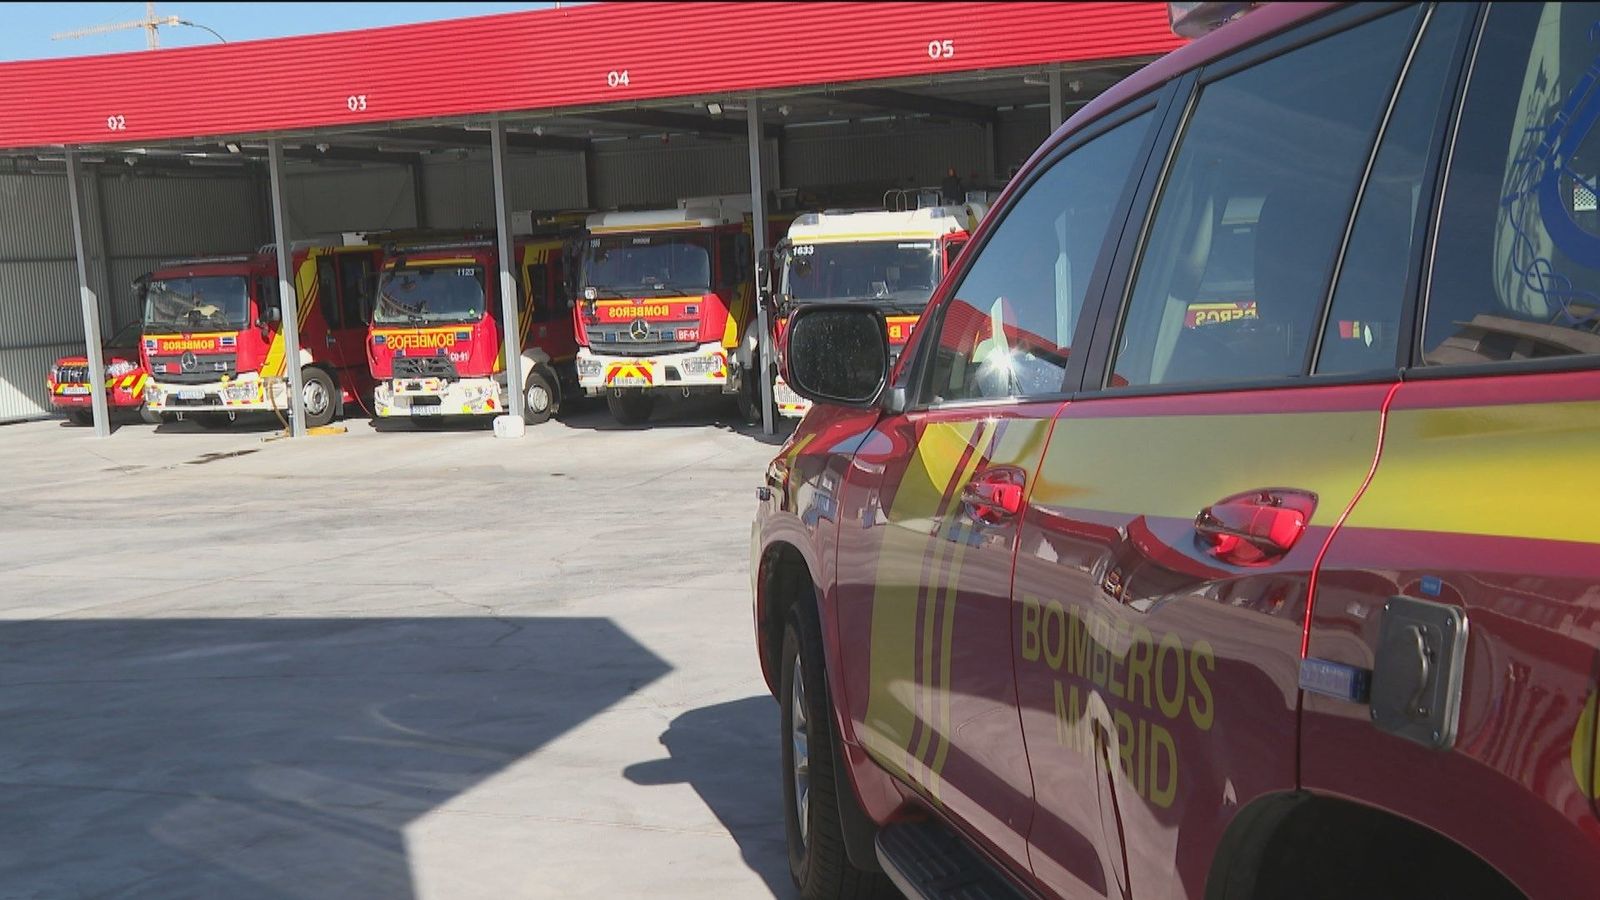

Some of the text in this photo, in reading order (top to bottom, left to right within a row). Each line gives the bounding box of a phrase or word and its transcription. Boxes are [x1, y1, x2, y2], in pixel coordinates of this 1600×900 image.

[928, 39, 954, 60] 05
[606, 69, 631, 88] 04
[347, 94, 368, 112] 03
[106, 114, 127, 131] 02
[456, 267, 475, 277] 1123
[677, 328, 700, 341] BF-91
[1020, 594, 1216, 732] BOMBEROS
